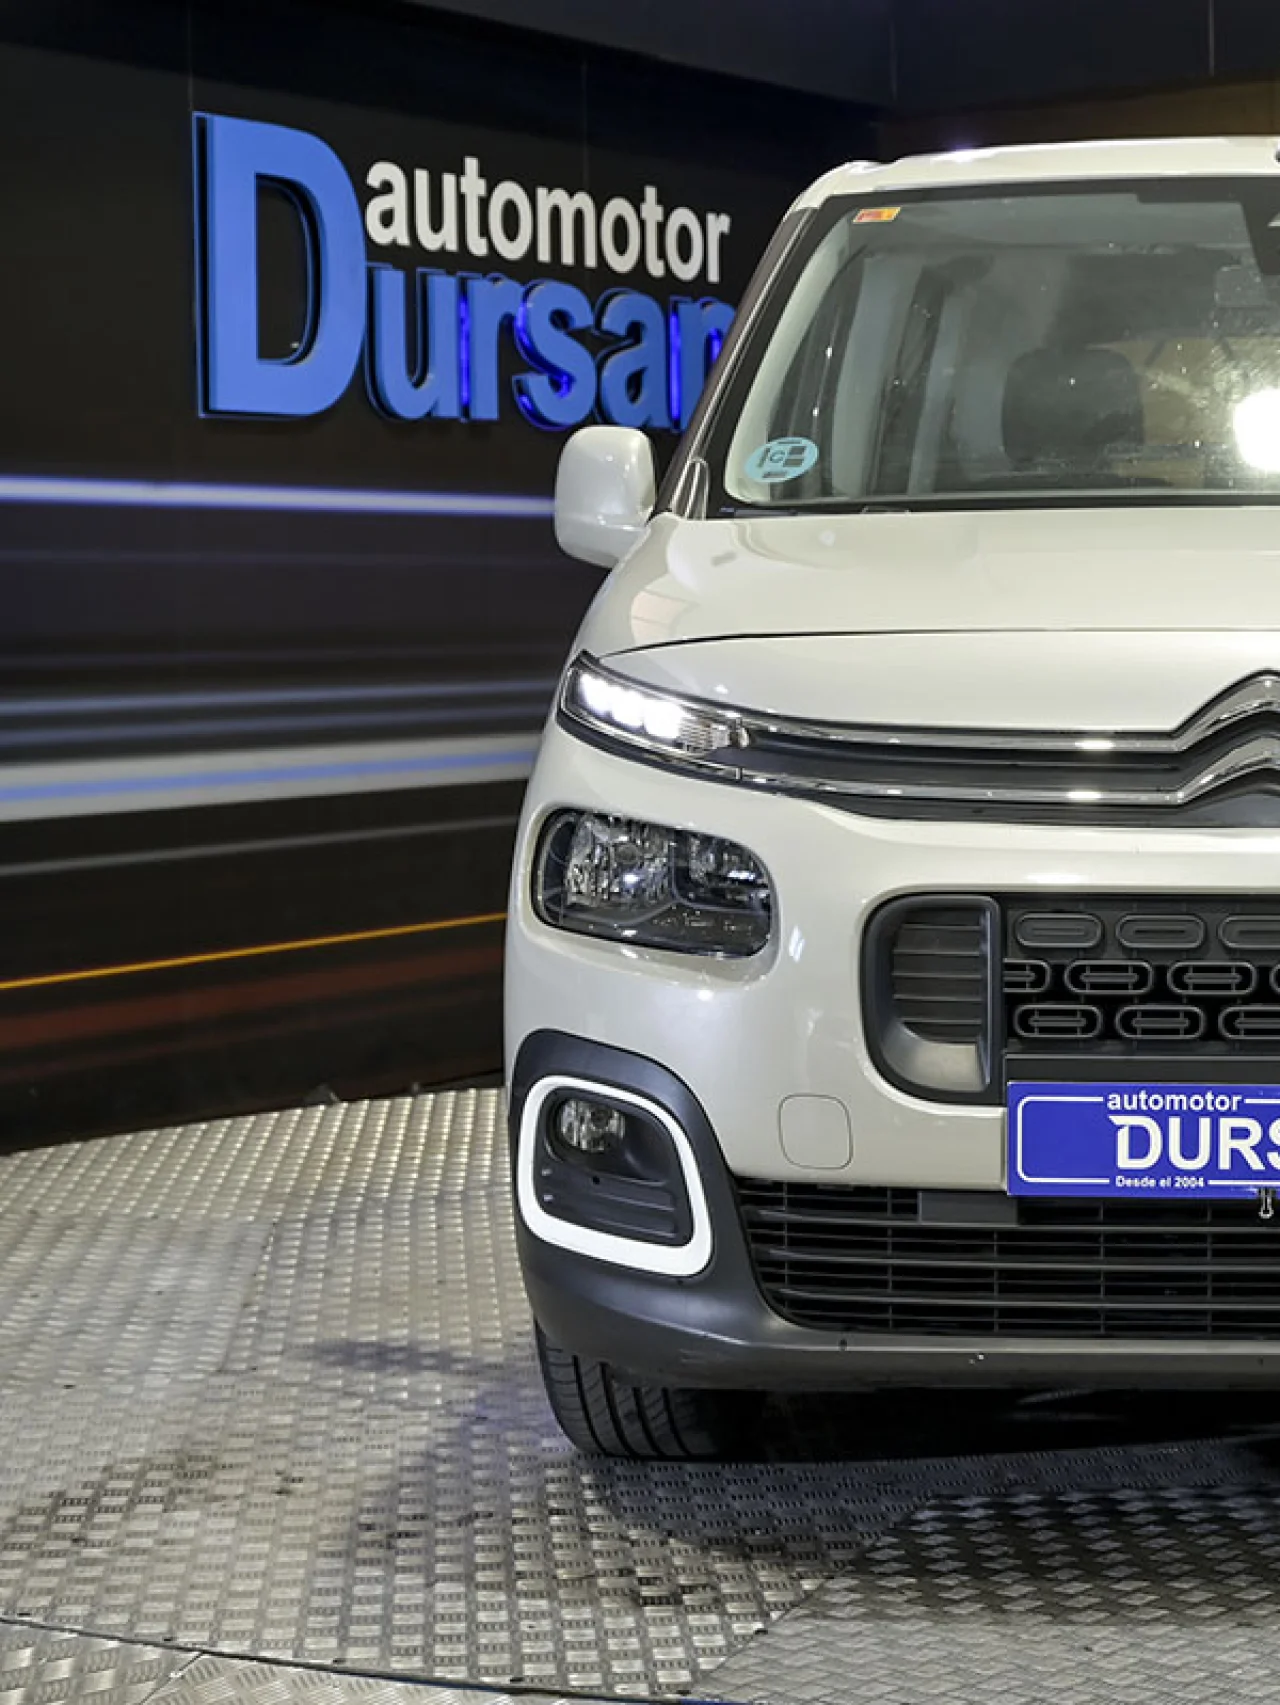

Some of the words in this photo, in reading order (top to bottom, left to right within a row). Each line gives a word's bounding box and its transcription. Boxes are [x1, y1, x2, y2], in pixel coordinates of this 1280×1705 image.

[365, 156, 731, 283] automotor
[1107, 1090, 1242, 1111] automotor
[1115, 1176, 1156, 1188] Desde
[1160, 1176, 1171, 1188] el
[1174, 1176, 1204, 1188] 2004
